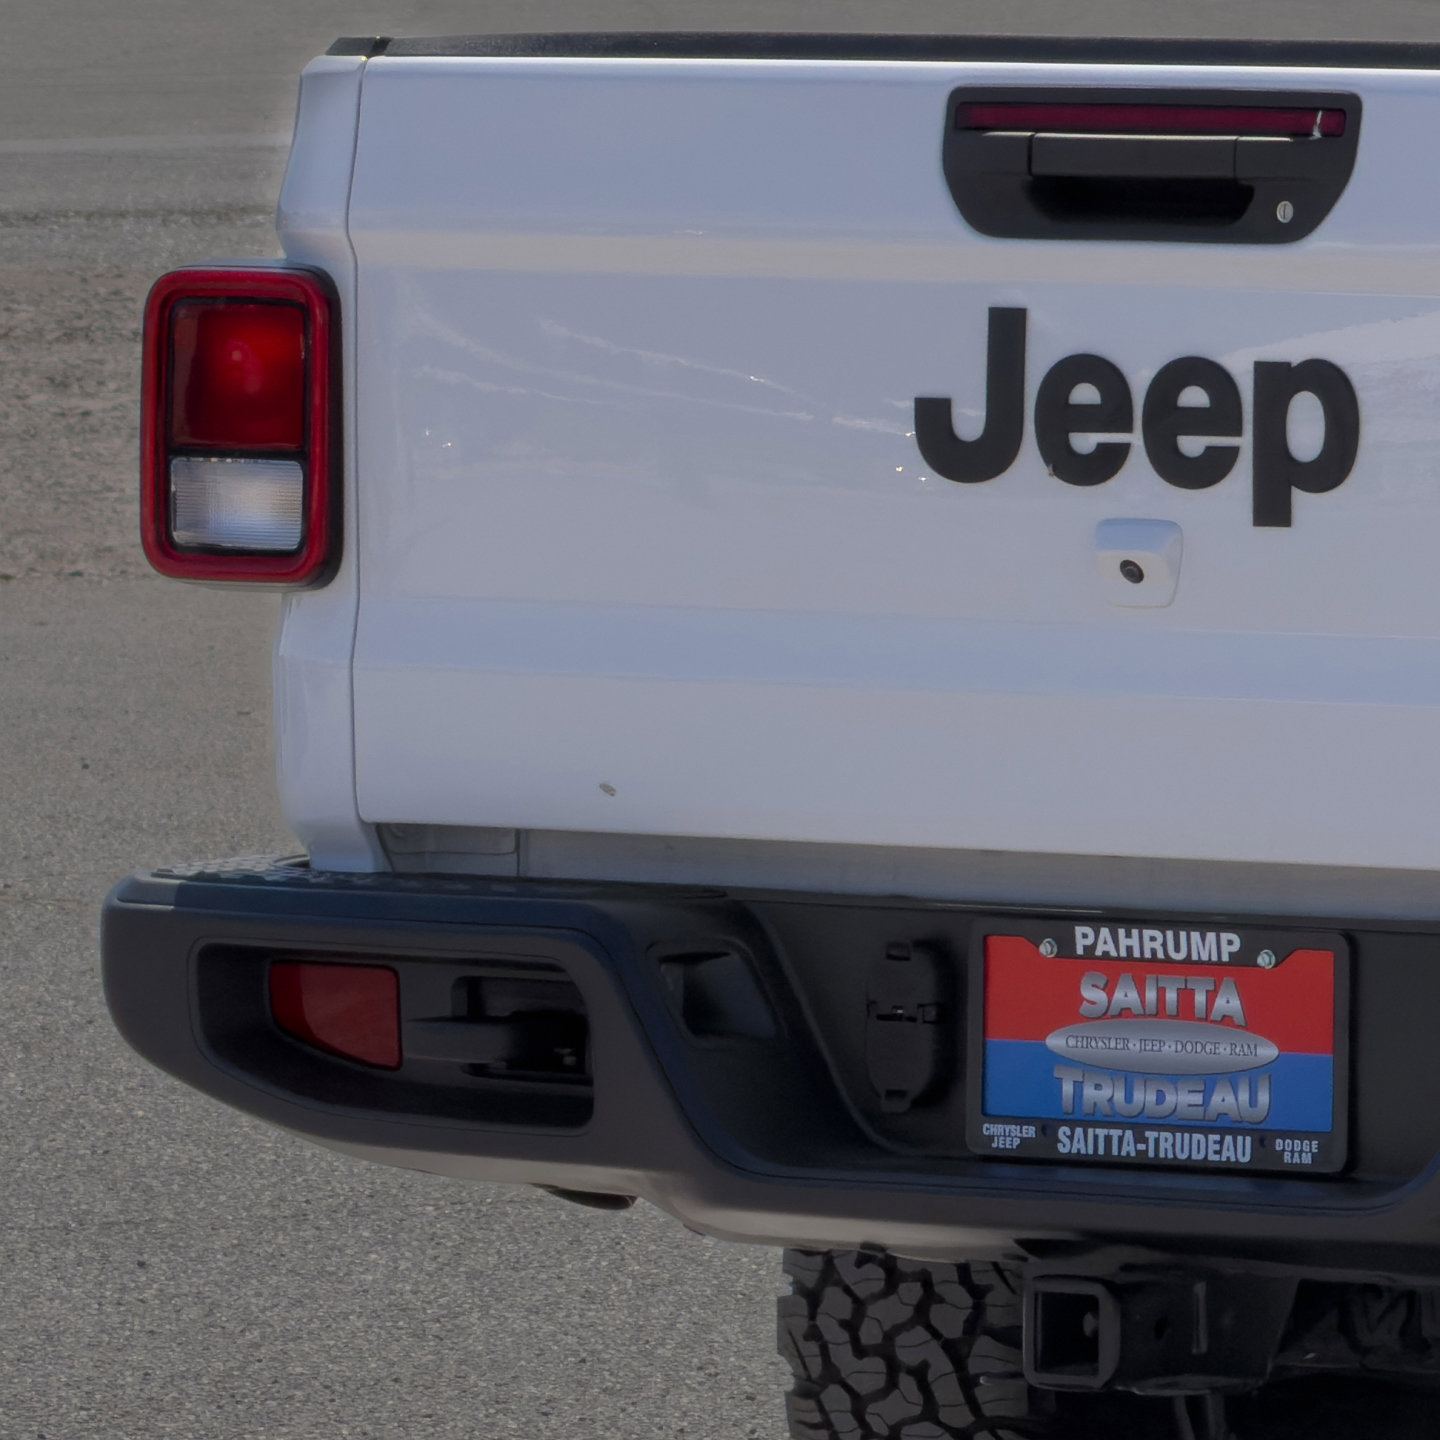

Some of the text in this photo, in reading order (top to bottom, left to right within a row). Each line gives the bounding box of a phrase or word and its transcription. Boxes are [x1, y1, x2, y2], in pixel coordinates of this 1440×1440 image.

[914, 306, 1360, 528] Jeep
[1073, 926, 1242, 963] PAHRUMP
[1078, 971, 1247, 1027] SAITTA
[1065, 1034, 1258, 1058] CHRYSLER JEEP DODGE RAM
[1053, 1064, 1272, 1125] TRUDEAU
[982, 1122, 1037, 1139] CHRYSLER
[991, 1136, 1022, 1150] JEEP
[1057, 1125, 1252, 1163] SAITTA-TRUDEAU
[1274, 1138, 1319, 1153] DODGE
[1283, 1150, 1313, 1165] RAM
